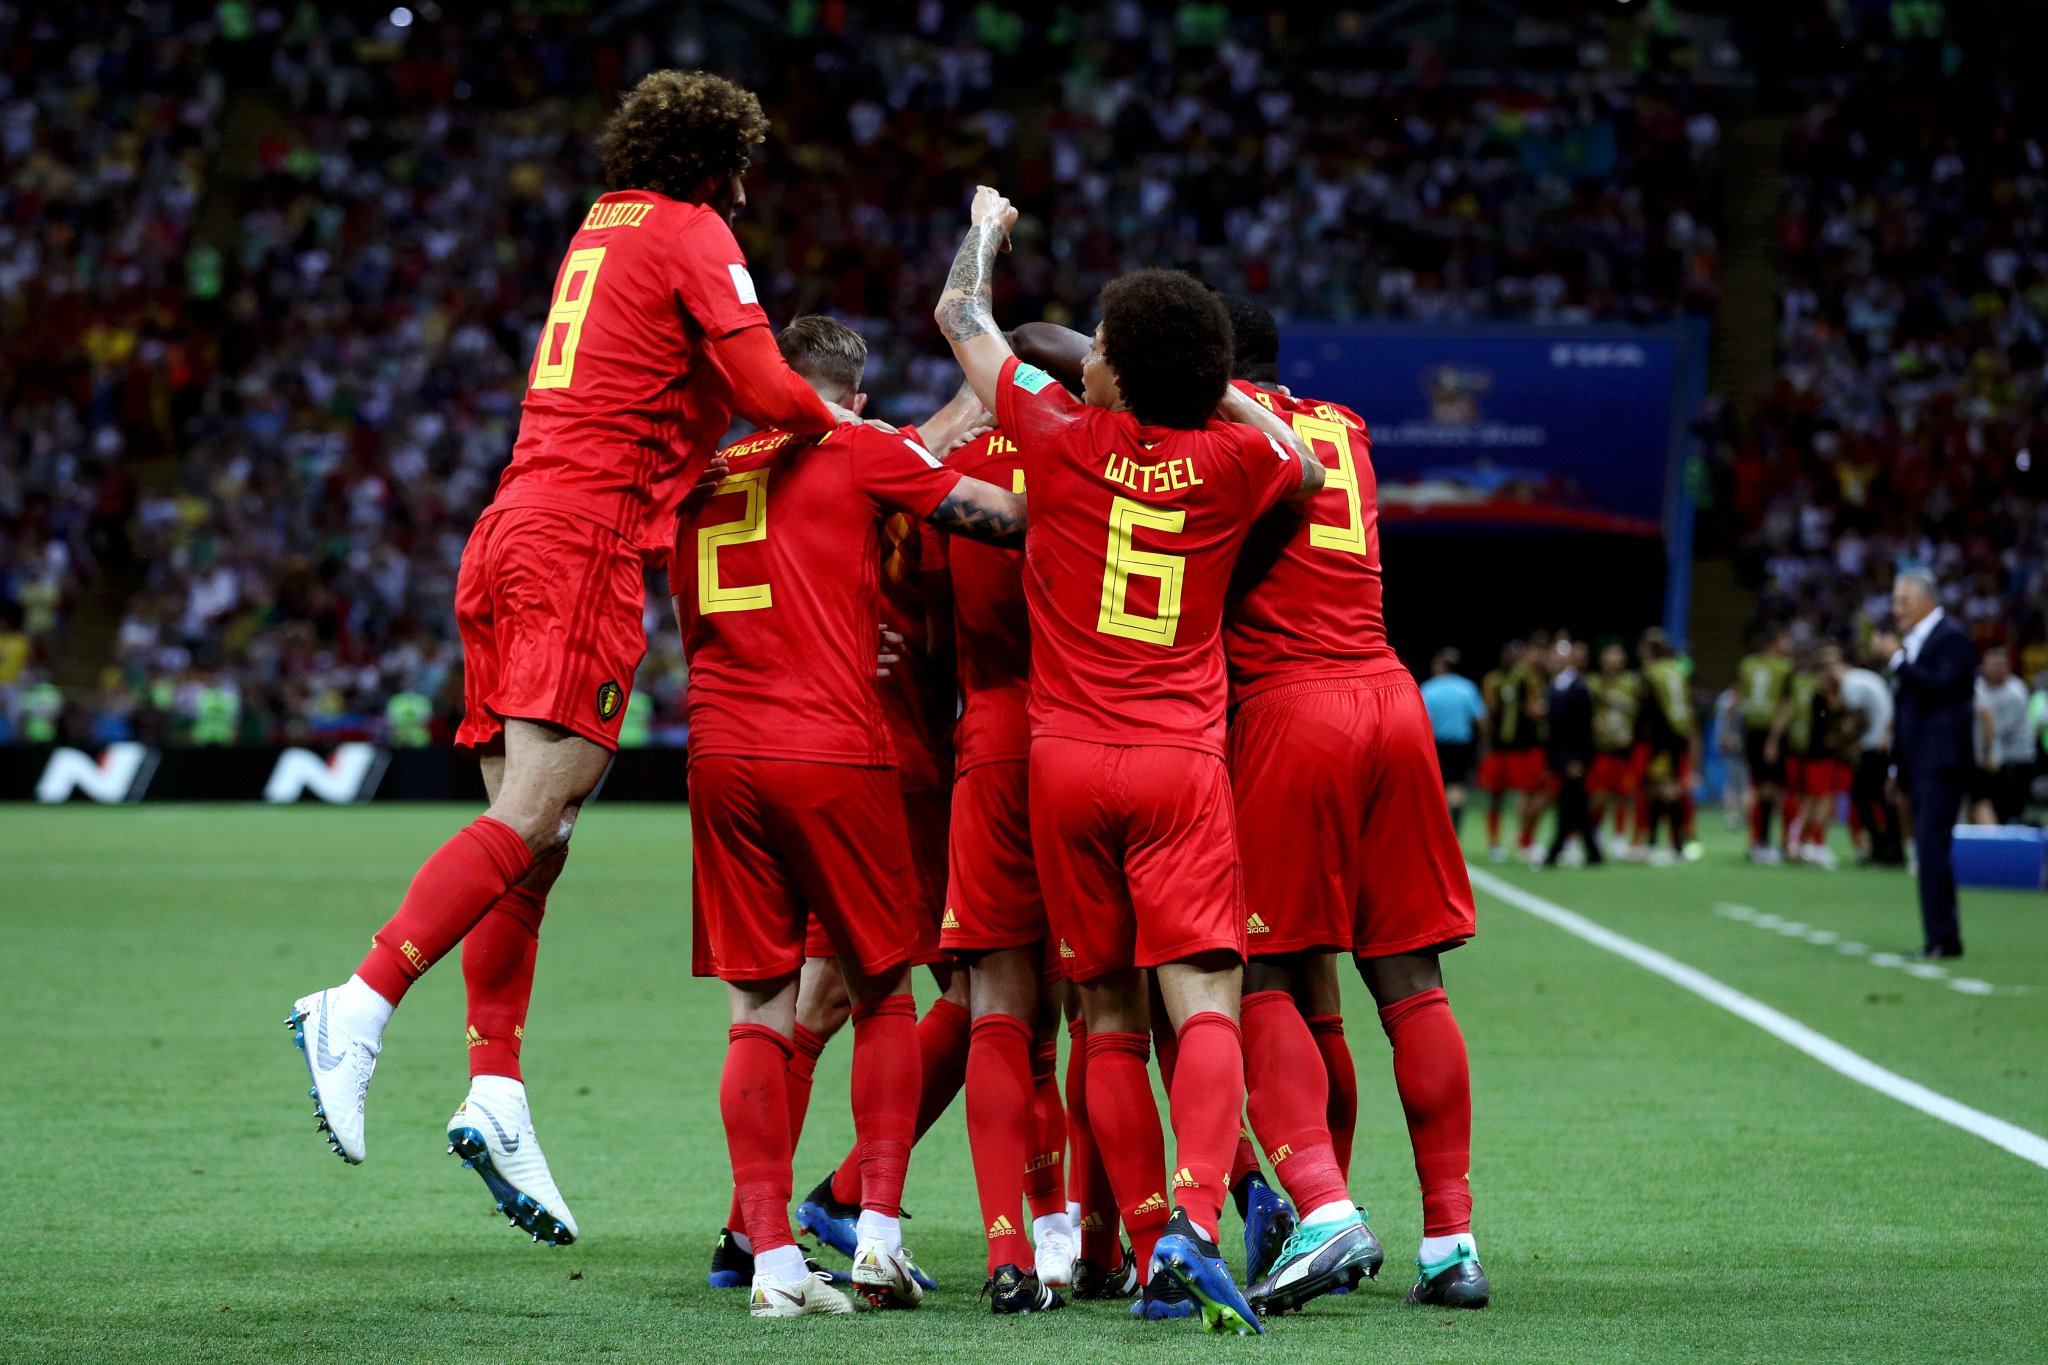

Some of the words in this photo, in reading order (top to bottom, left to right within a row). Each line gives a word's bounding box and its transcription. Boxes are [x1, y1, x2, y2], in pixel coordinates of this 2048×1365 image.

[583, 203, 655, 230] ELLAINI
[531, 246, 607, 390] 8
[1104, 453, 1204, 493] WITSEL
[1292, 413, 1367, 556] 9
[697, 467, 773, 616] 2
[1096, 496, 1187, 647] 6
[400, 939, 430, 972] BELG
[988, 1228, 1017, 1239] adidas
